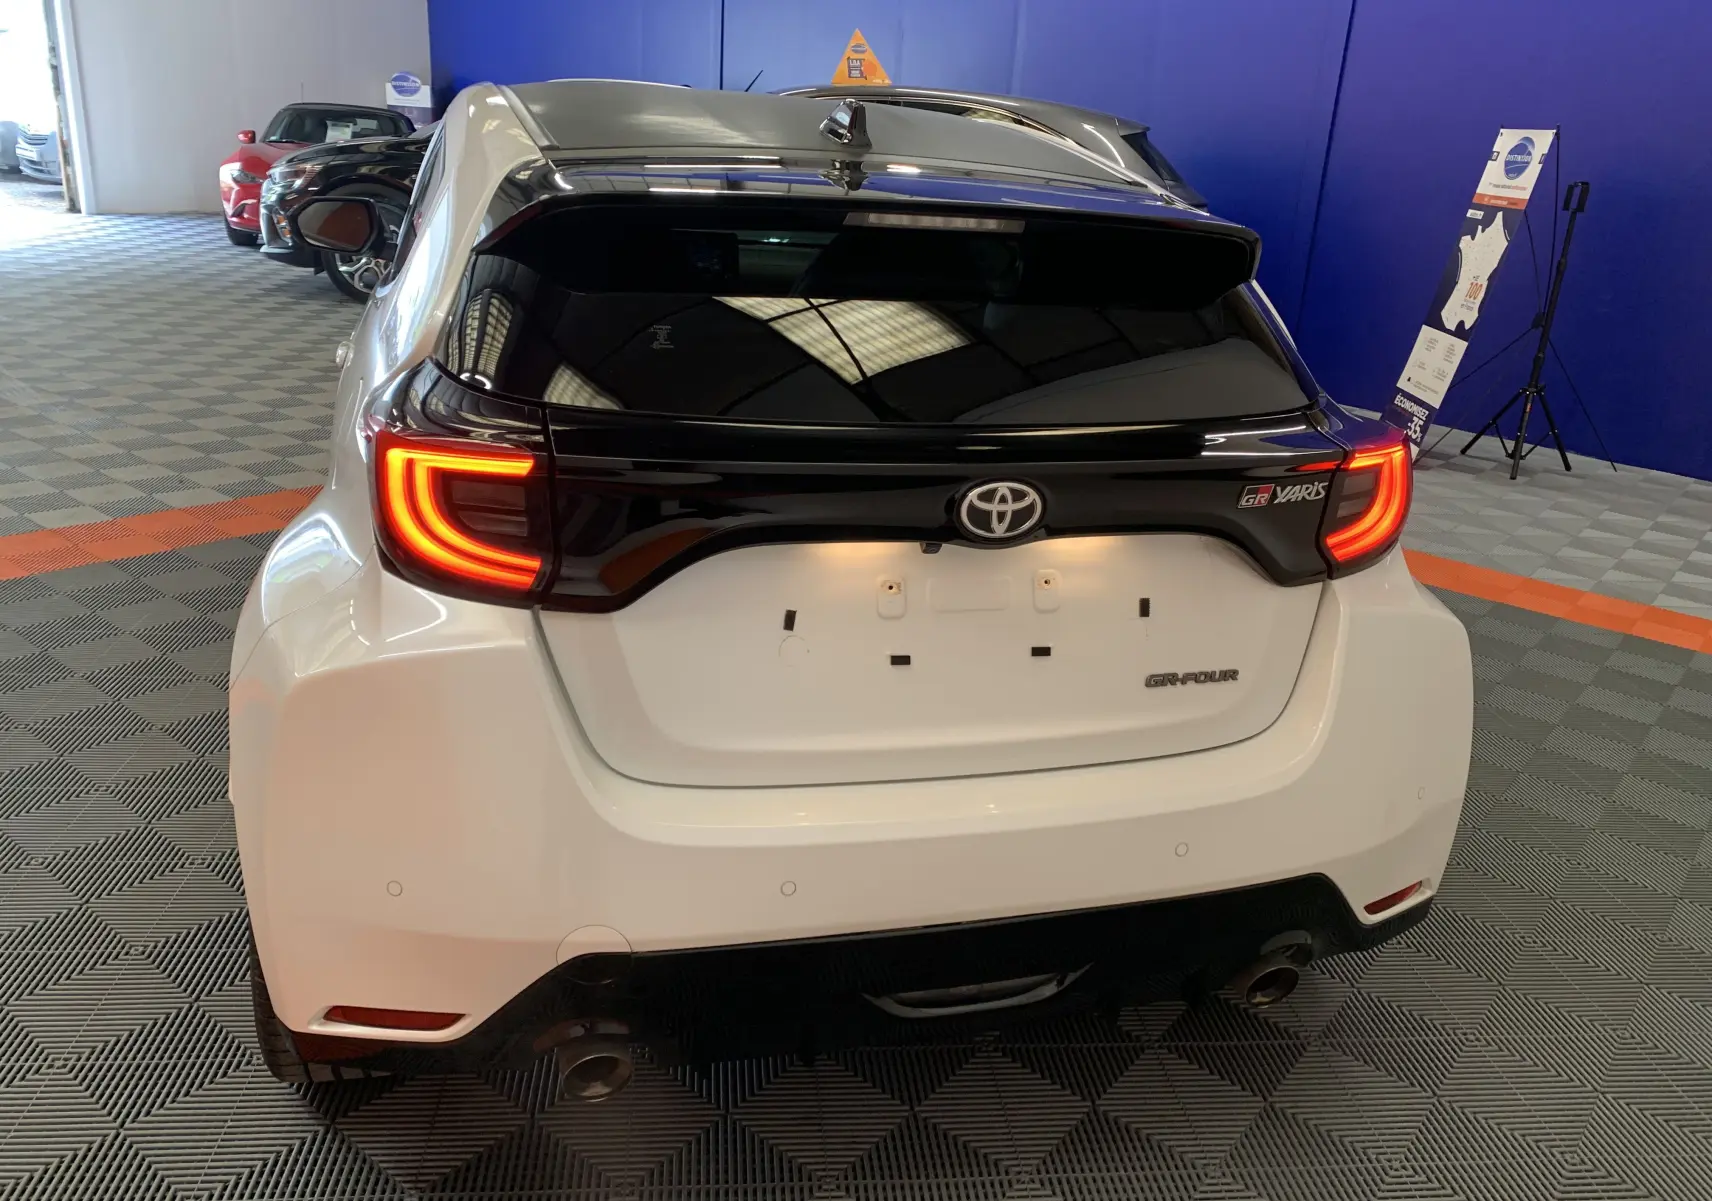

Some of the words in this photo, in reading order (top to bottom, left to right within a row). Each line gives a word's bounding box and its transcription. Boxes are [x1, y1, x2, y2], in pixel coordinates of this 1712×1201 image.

[1465, 281, 1483, 300] 100
[1394, 392, 1429, 420] ÉCONOMISEZ
[1241, 493, 1269, 506] GR
[1274, 481, 1328, 504] YARIS
[1145, 669, 1239, 687] GR-FOUR
